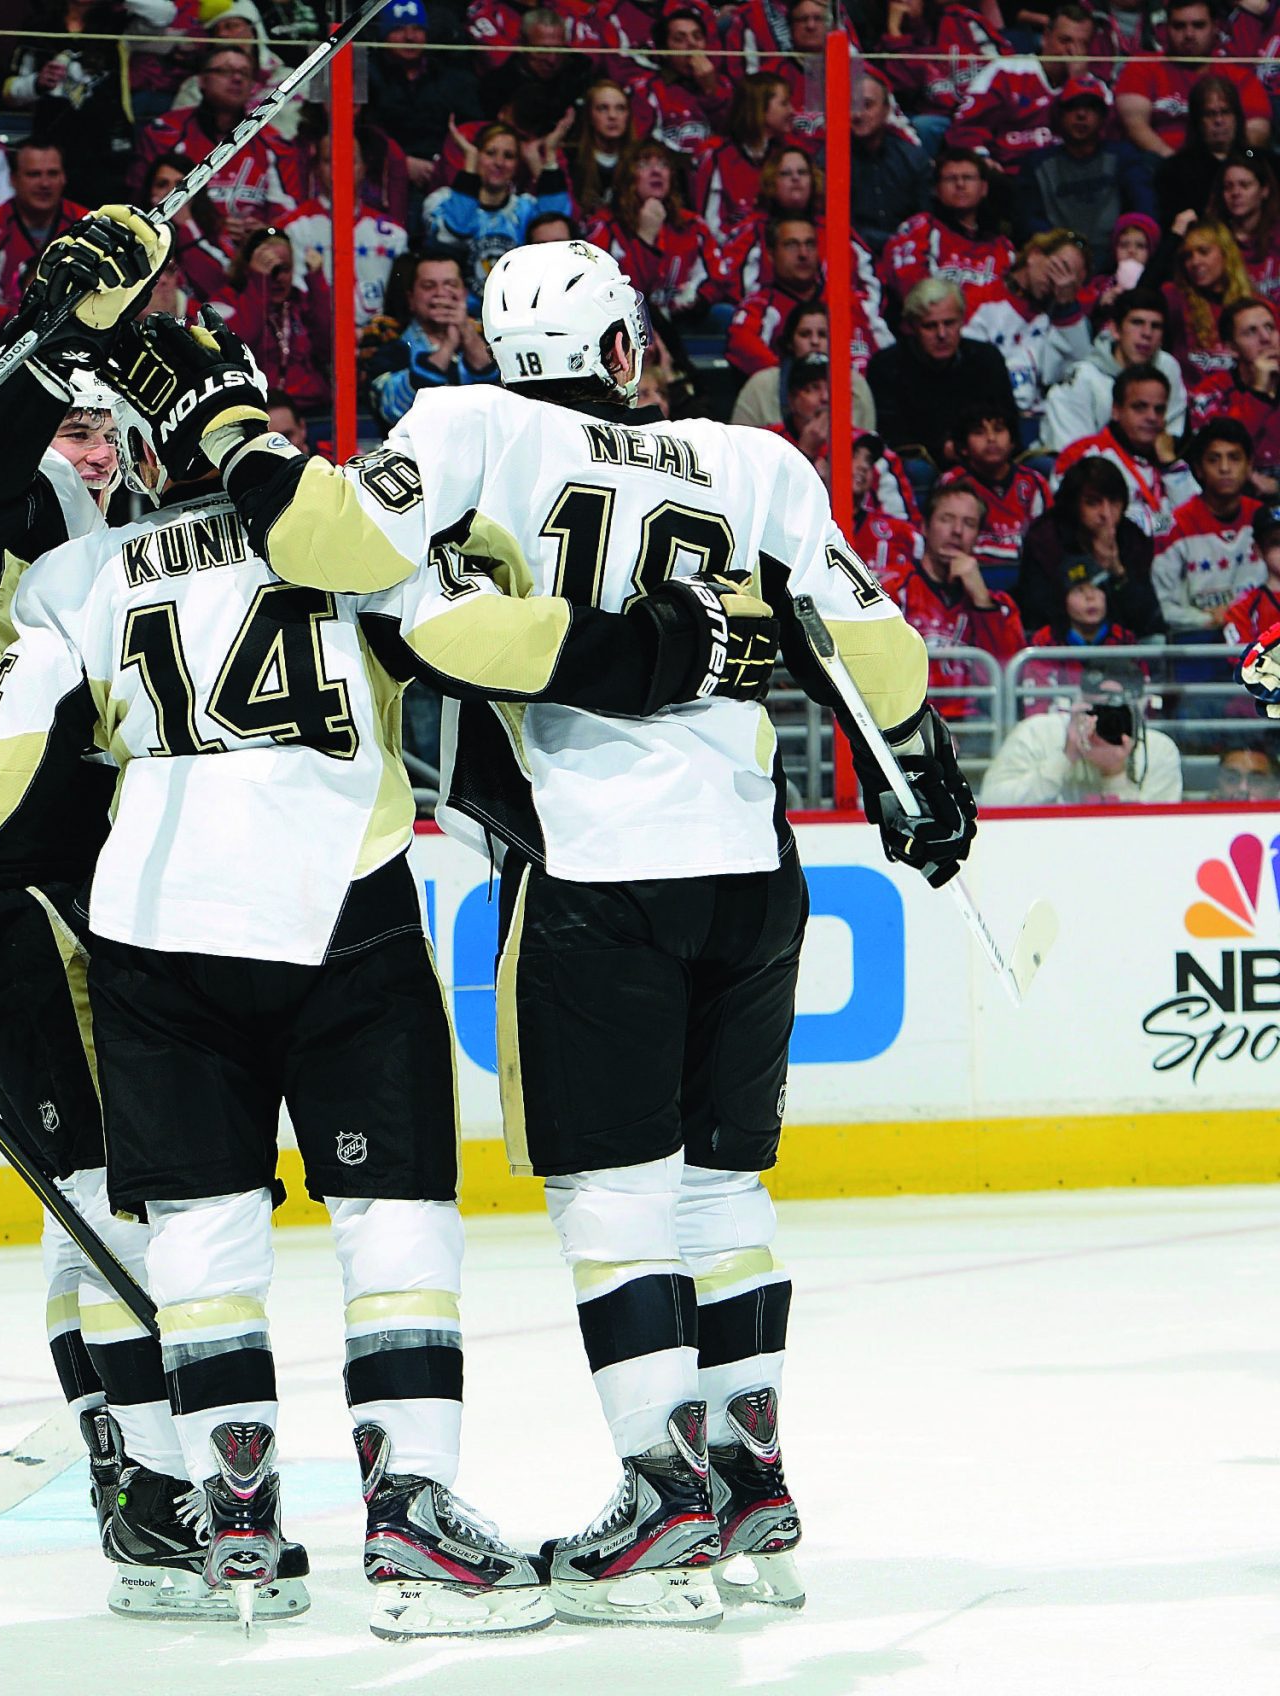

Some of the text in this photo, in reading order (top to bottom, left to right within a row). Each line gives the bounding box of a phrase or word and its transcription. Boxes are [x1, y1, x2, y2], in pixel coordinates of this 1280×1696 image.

[515, 351, 543, 377] 18
[583, 423, 713, 489] NEAL
[182, 497, 233, 514] Reebo
[121, 510, 247, 589] KUNI
[825, 542, 892, 610] 1
[120, 579, 360, 761] 14
[96, 1417, 109, 1452] Reebok
[443, 1542, 480, 1562] BAUER
[602, 1530, 637, 1553] BAUER
[121, 1576, 157, 1588] Reebok
